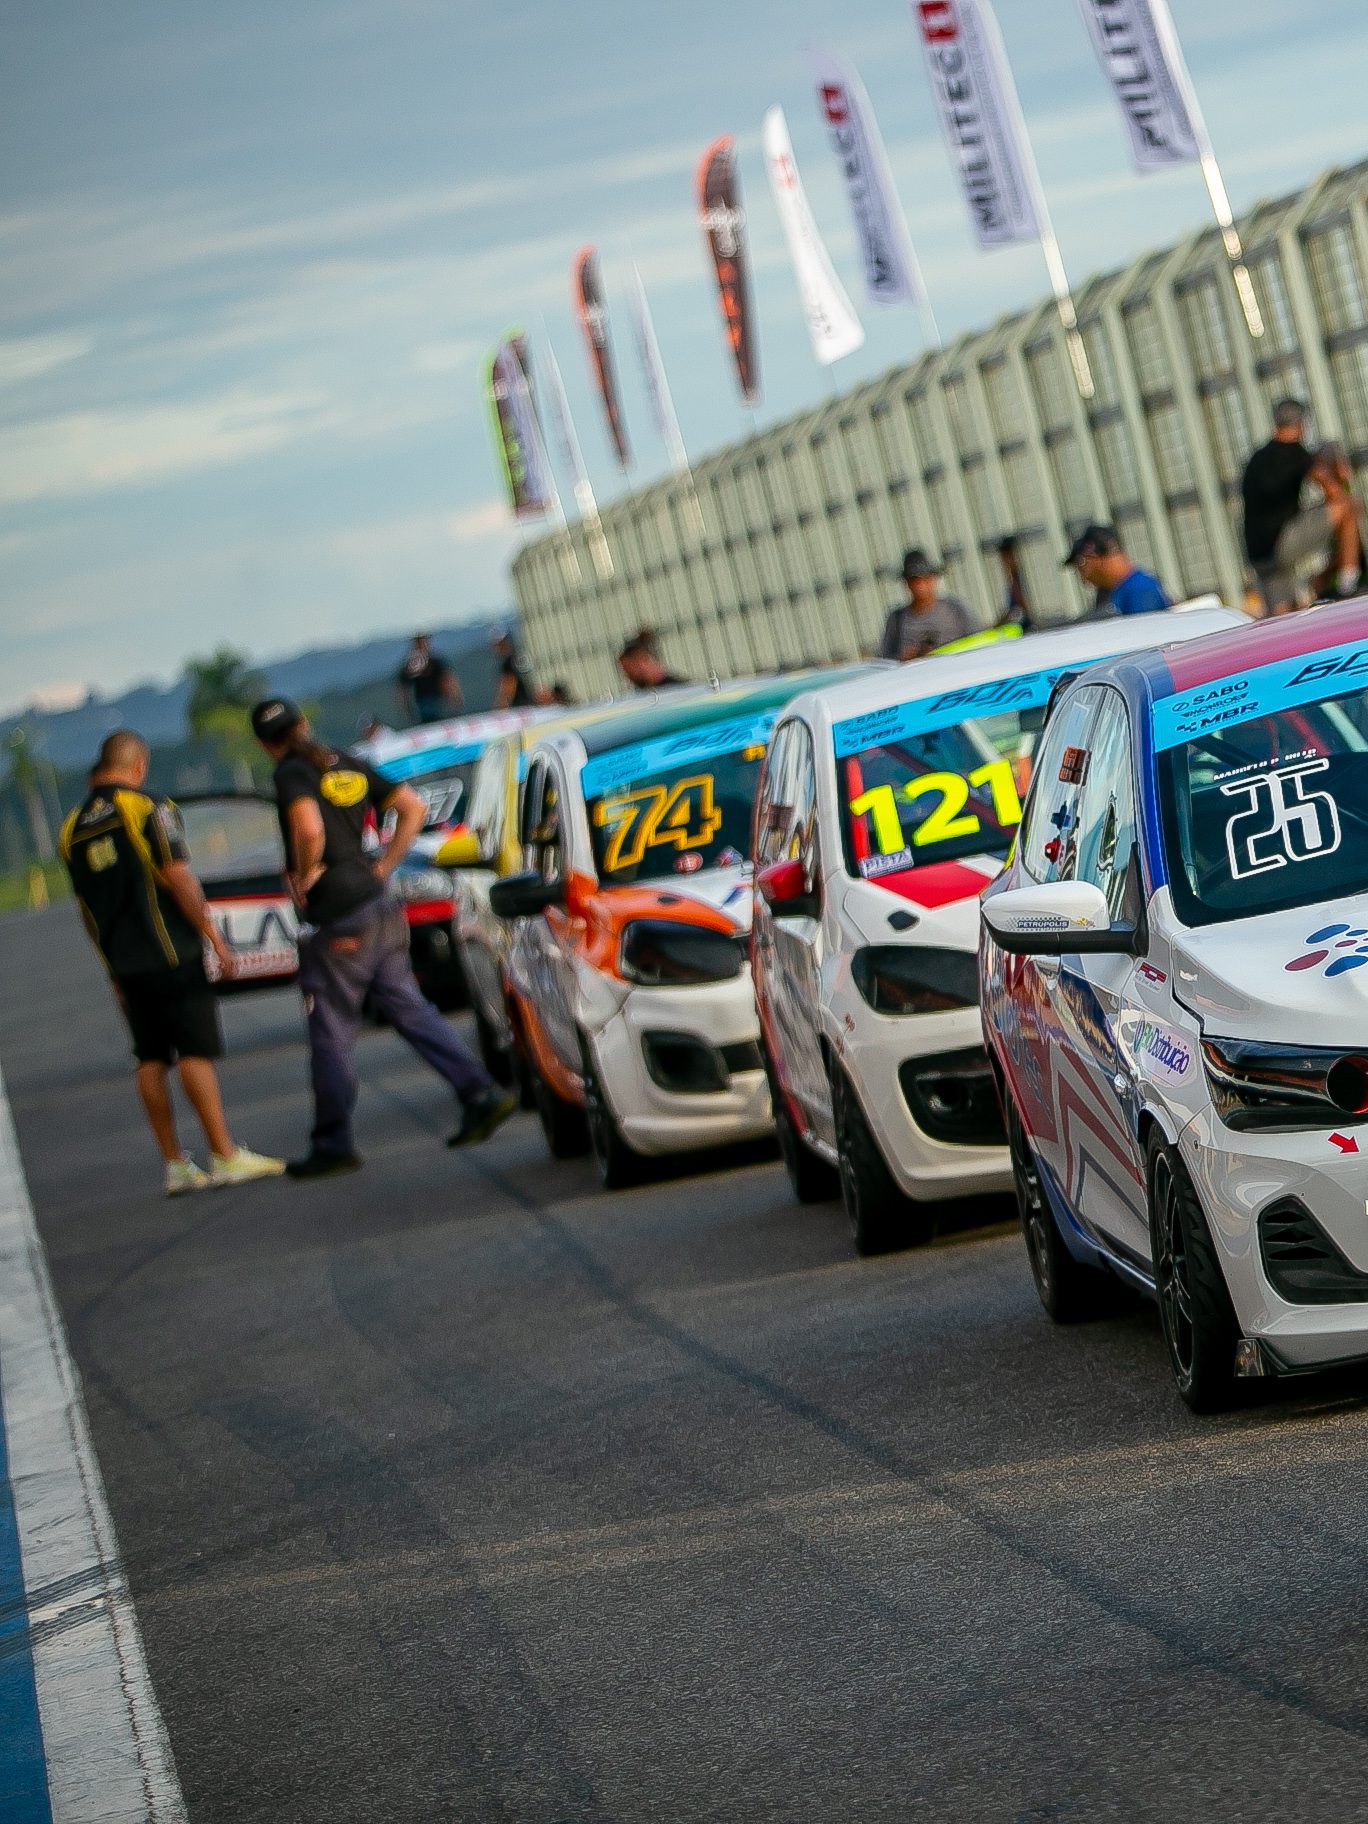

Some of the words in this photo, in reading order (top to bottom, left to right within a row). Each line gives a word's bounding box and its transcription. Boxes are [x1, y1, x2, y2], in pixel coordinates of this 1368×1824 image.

[1200, 701, 1259, 728] MBR
[592, 773, 722, 872] 74
[849, 758, 1023, 855] 121
[1220, 758, 1342, 880] 25
